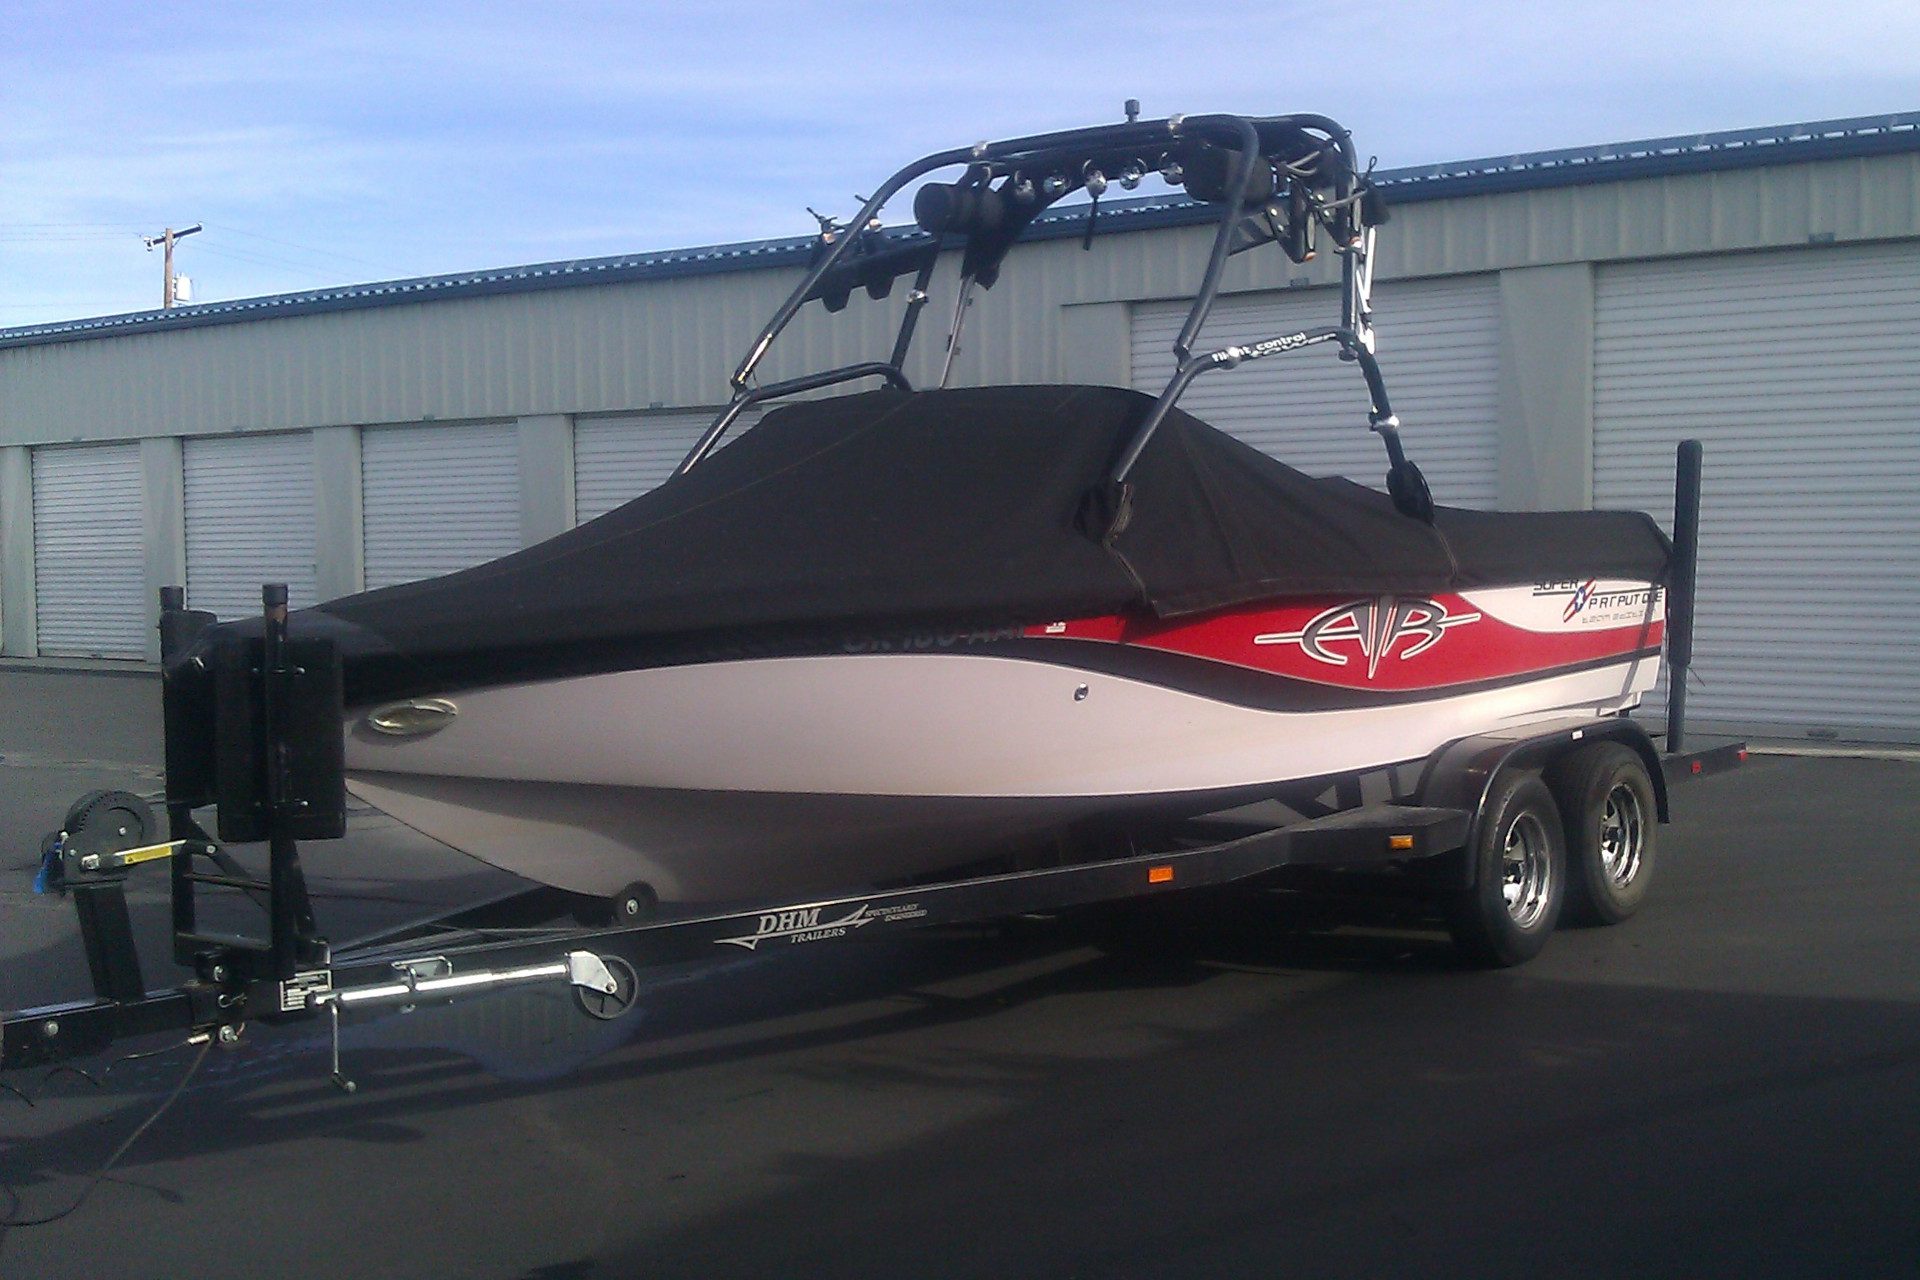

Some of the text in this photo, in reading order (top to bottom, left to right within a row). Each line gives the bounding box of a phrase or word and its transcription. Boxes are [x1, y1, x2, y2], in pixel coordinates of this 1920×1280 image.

[1211, 332, 1307, 362] flit control
[757, 907, 821, 934] DHM
[790, 927, 847, 944] TRAILERS
